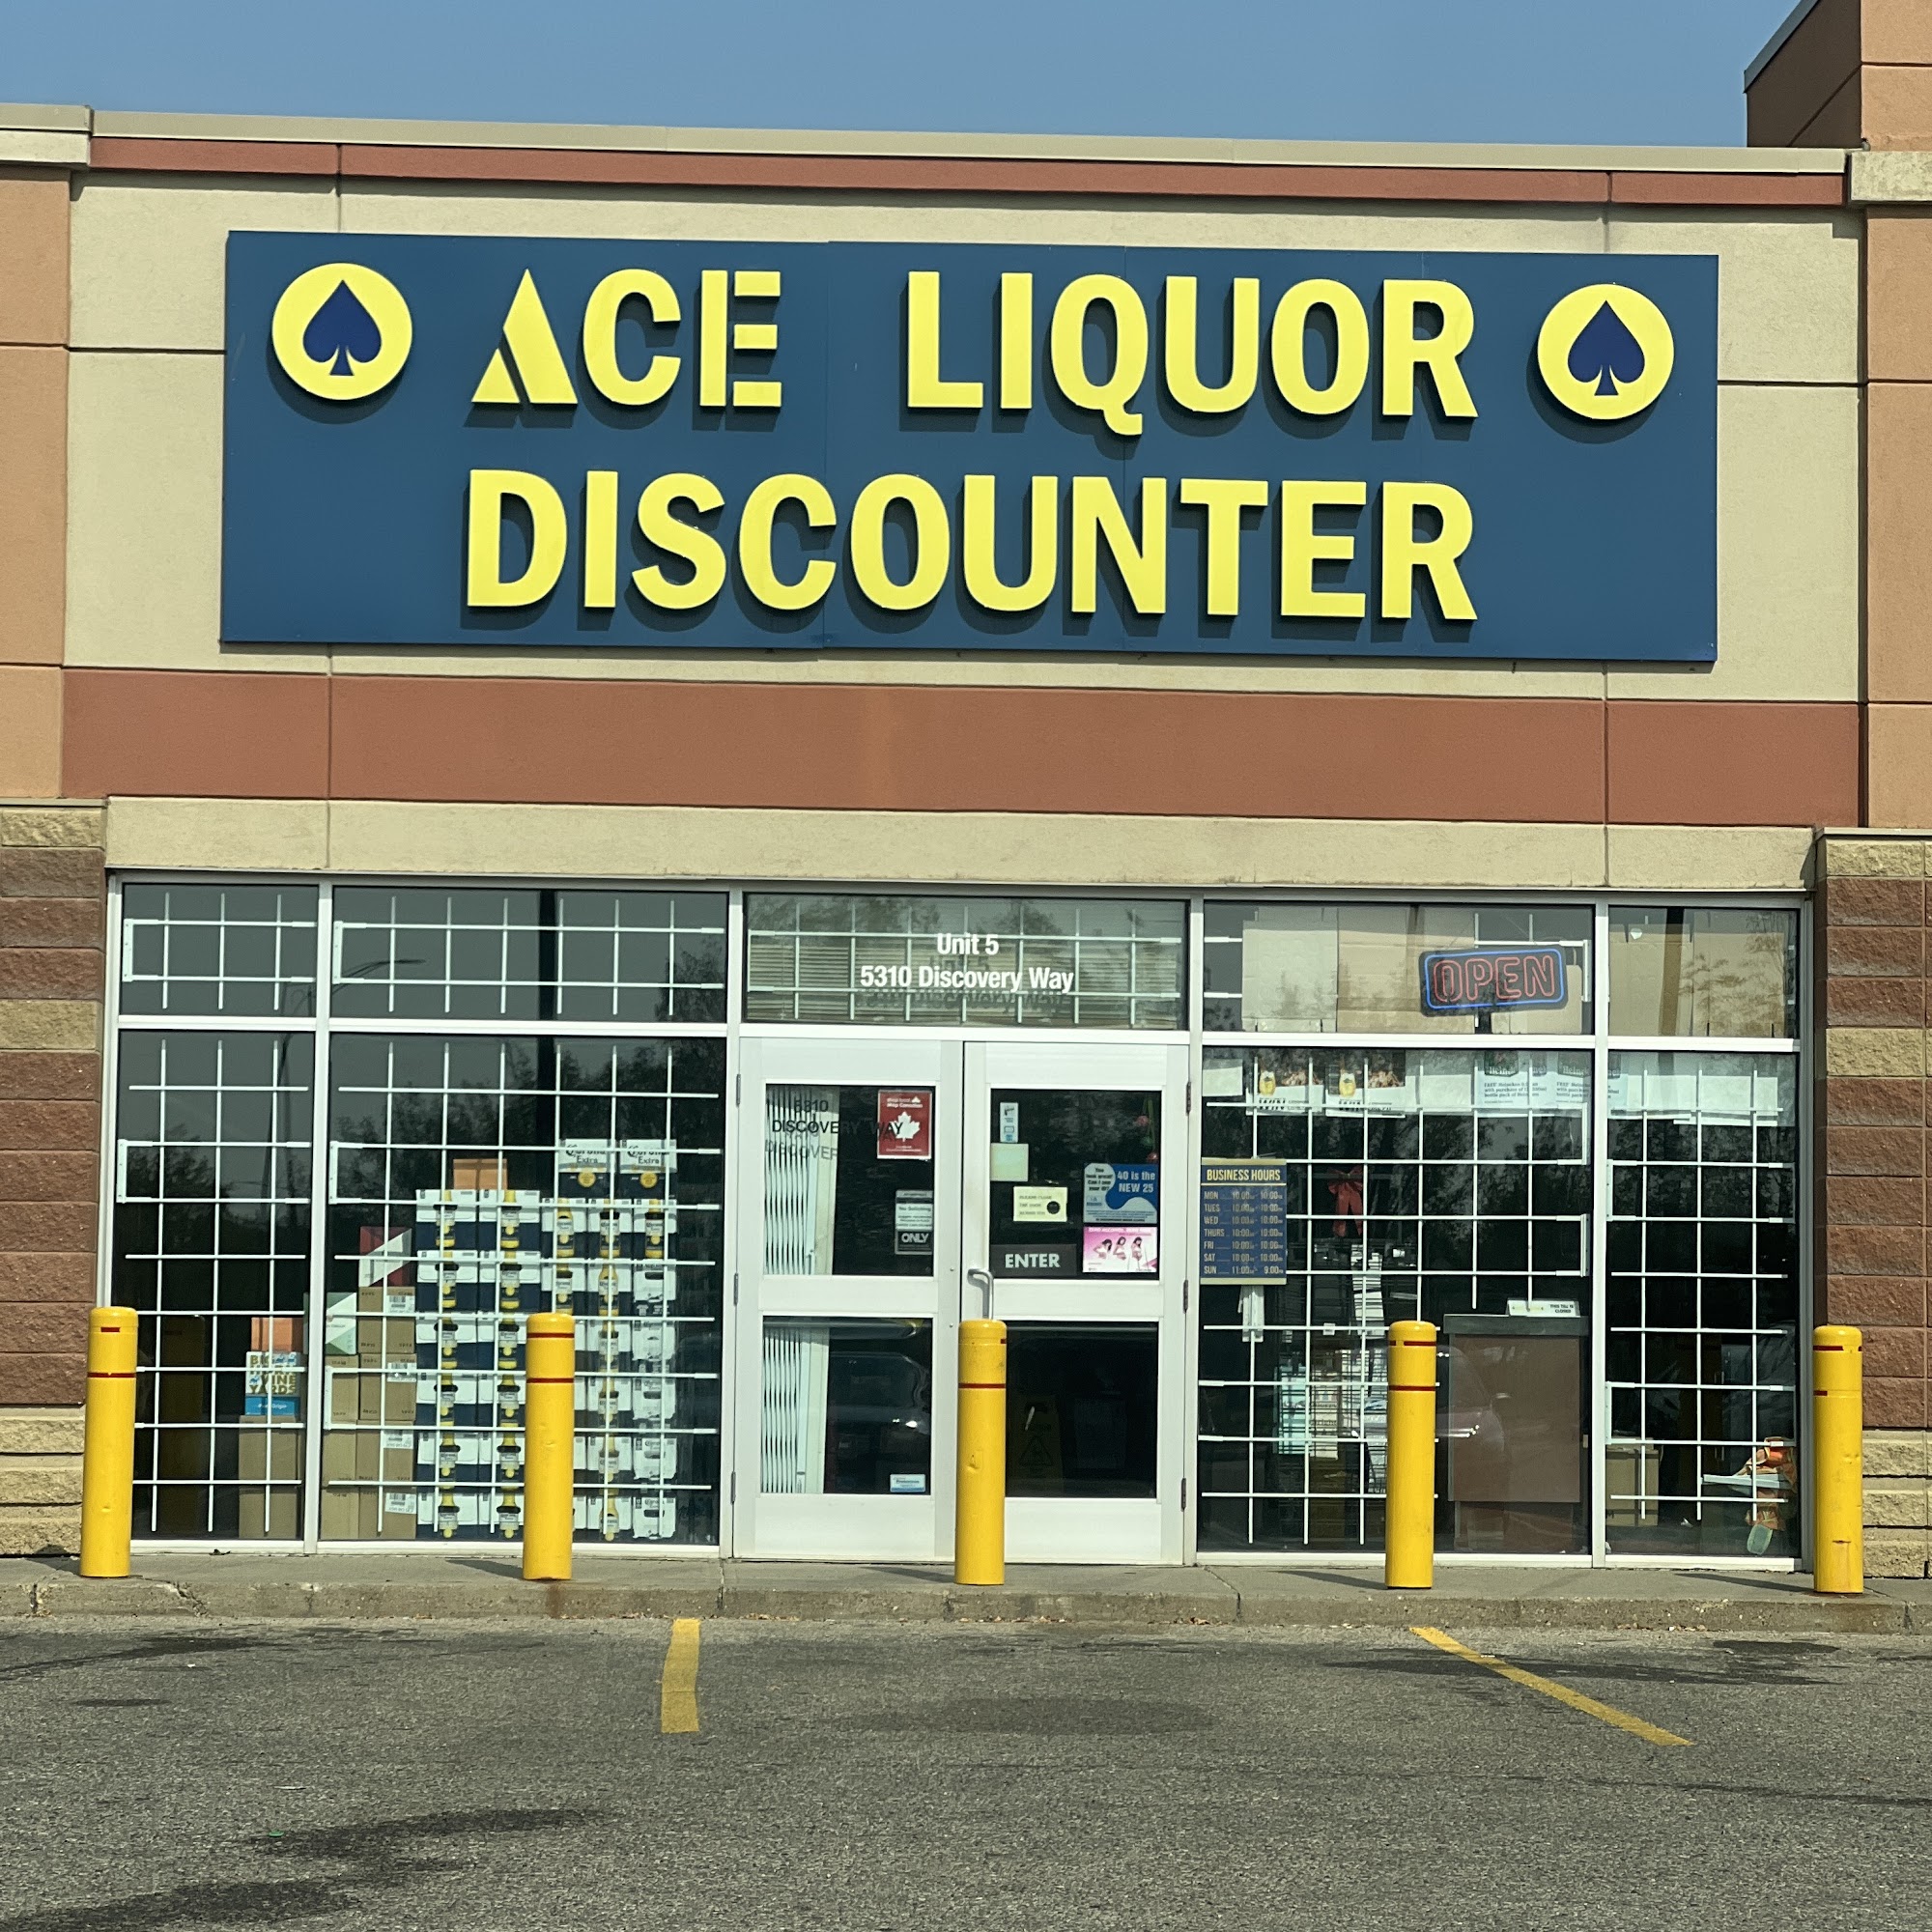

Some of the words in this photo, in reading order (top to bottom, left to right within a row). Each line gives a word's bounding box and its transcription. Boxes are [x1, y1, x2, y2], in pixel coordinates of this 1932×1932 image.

[473, 270, 781, 406] ACE
[909, 271, 1476, 435] LIQUOR
[469, 469, 1476, 619] DISCOUNTER
[937, 932, 980, 955] Unit
[984, 933, 999, 955] 5
[860, 965, 911, 988] 5310
[919, 965, 1021, 993] Discovery
[1029, 967, 1074, 994] Way
[1433, 954, 1555, 1003] OPEN
[870, 1121, 904, 1135] WAY
[576, 1155, 598, 1164] Extra
[1117, 1171, 1128, 1180] 40
[1131, 1171, 1139, 1180] is
[1141, 1171, 1156, 1180] the
[1207, 1169, 1250, 1181] BUSINESS
[1251, 1169, 1281, 1181] HOURS
[1118, 1183, 1141, 1193] NEW
[1142, 1183, 1154, 1193] 25
[1204, 1191, 1219, 1200] MON
[1204, 1204, 1220, 1212] TUES
[1204, 1216, 1219, 1225] WED
[901, 1232, 929, 1243] ONLY
[1204, 1229, 1225, 1237] THURS
[1204, 1241, 1214, 1250] FRI
[1005, 1253, 1061, 1268] ENTER
[1204, 1265, 1217, 1274] SUN
